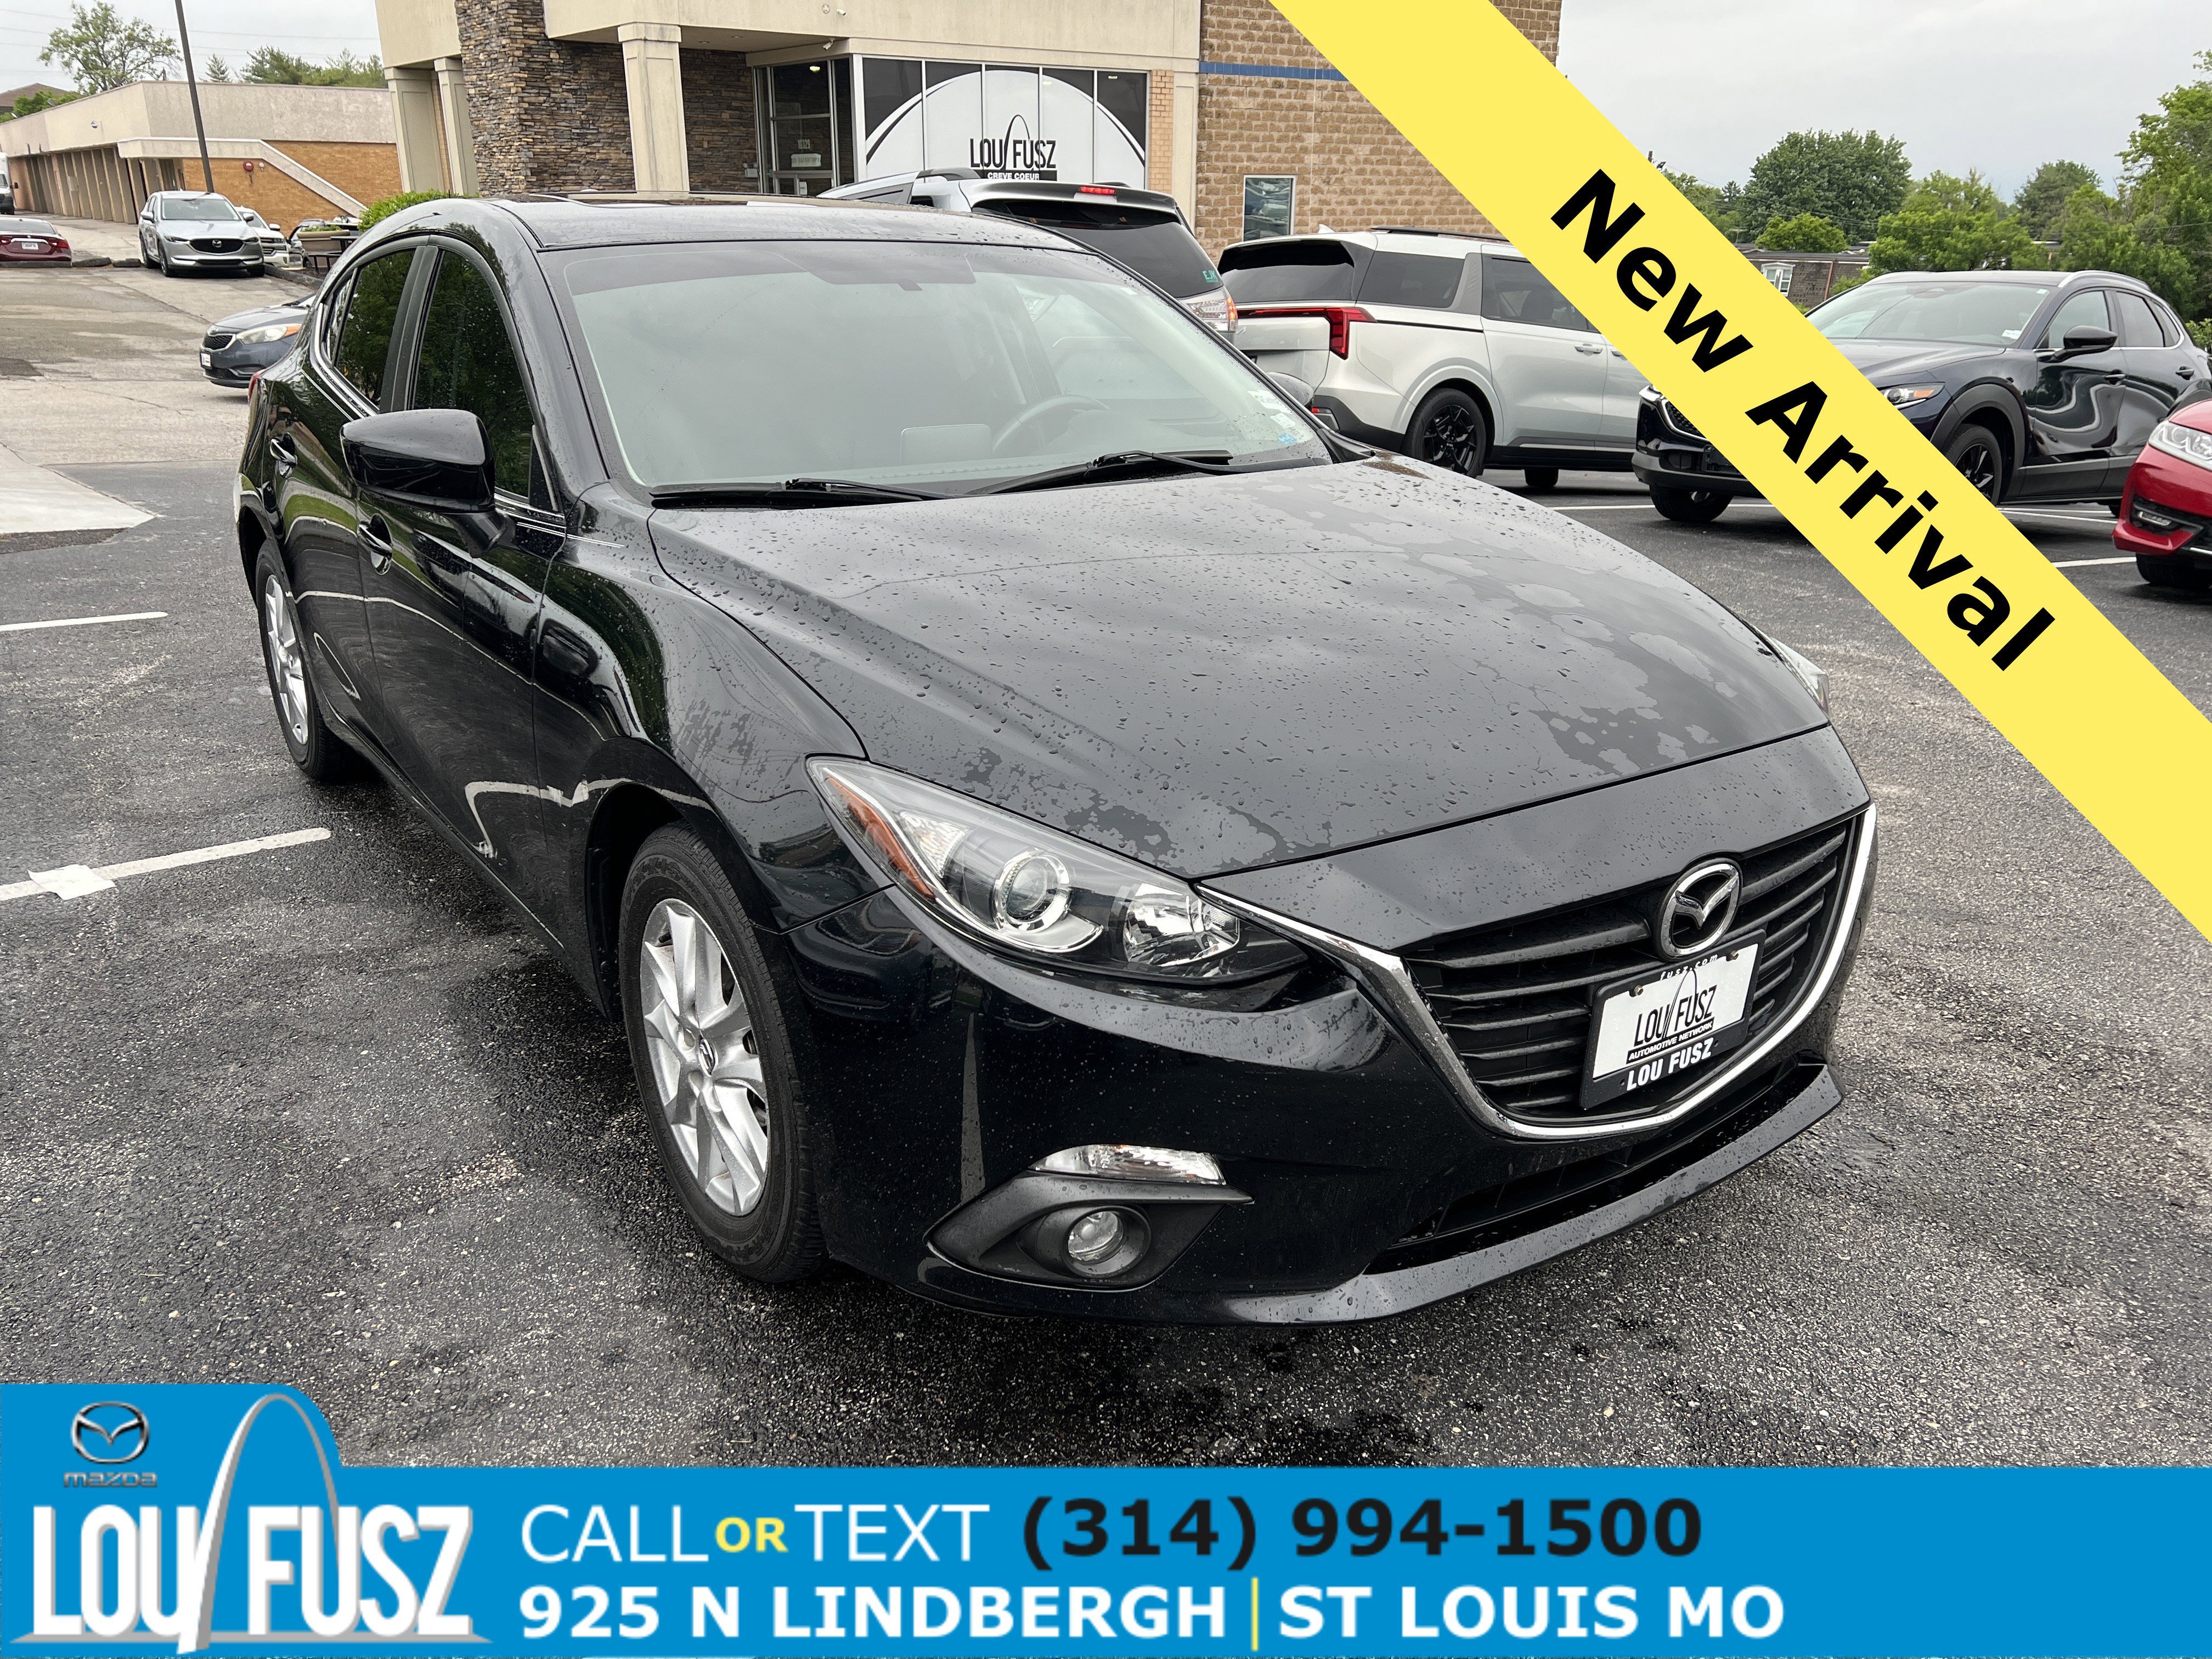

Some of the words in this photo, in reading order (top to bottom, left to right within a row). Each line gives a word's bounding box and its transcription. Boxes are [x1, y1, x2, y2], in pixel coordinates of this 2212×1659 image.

[970, 138, 1003, 168] LOU
[1013, 139, 1056, 168] FUSZ
[1660, 954, 1718, 981] fusz.com
[1634, 1003, 1671, 1047] LOU
[1674, 984, 1718, 1032] FUSZ
[1628, 1036, 1678, 1061] AUTOMOTIVE
[1678, 1020, 1713, 1042] NETWORK
[1626, 1058, 1663, 1091] LOU
[1668, 1037, 1714, 1074] FUSZ
